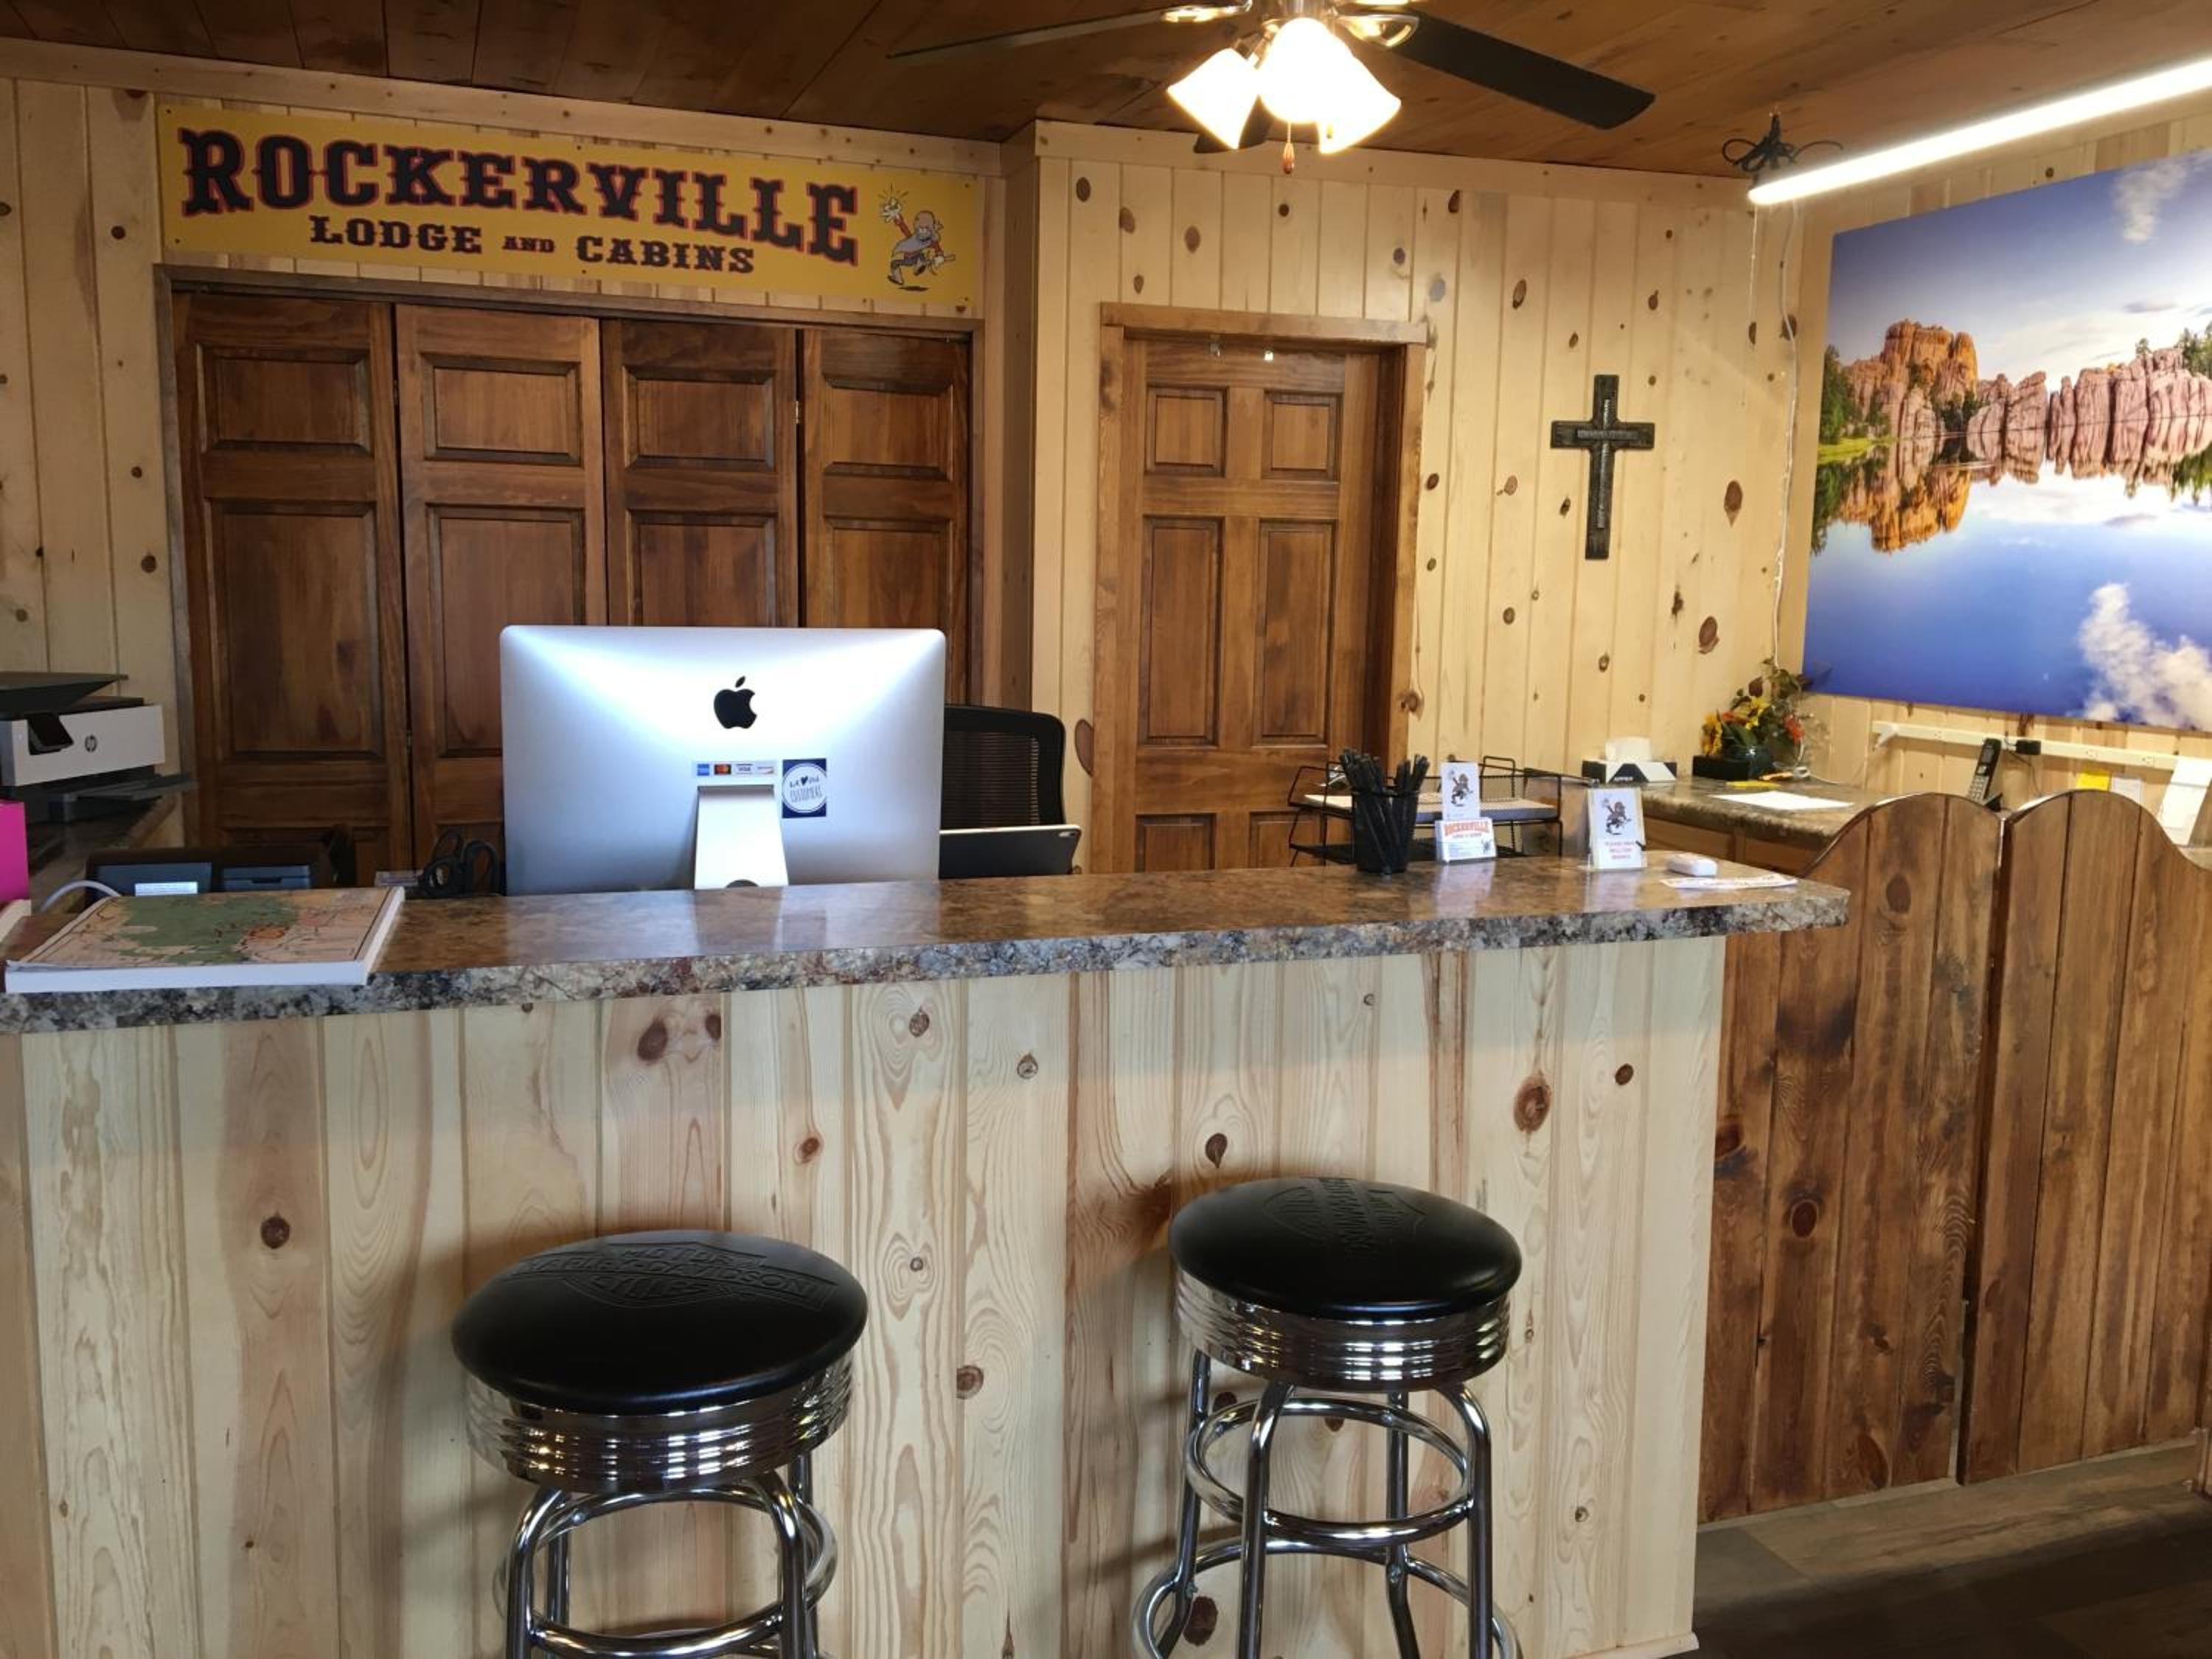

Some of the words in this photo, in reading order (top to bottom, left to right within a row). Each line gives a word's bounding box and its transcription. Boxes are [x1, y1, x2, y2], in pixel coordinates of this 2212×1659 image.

[178, 127, 858, 267] ROCKERVILLE
[308, 215, 483, 254] LODGE
[502, 234, 555, 254] AND
[576, 235, 754, 274] CABINS
